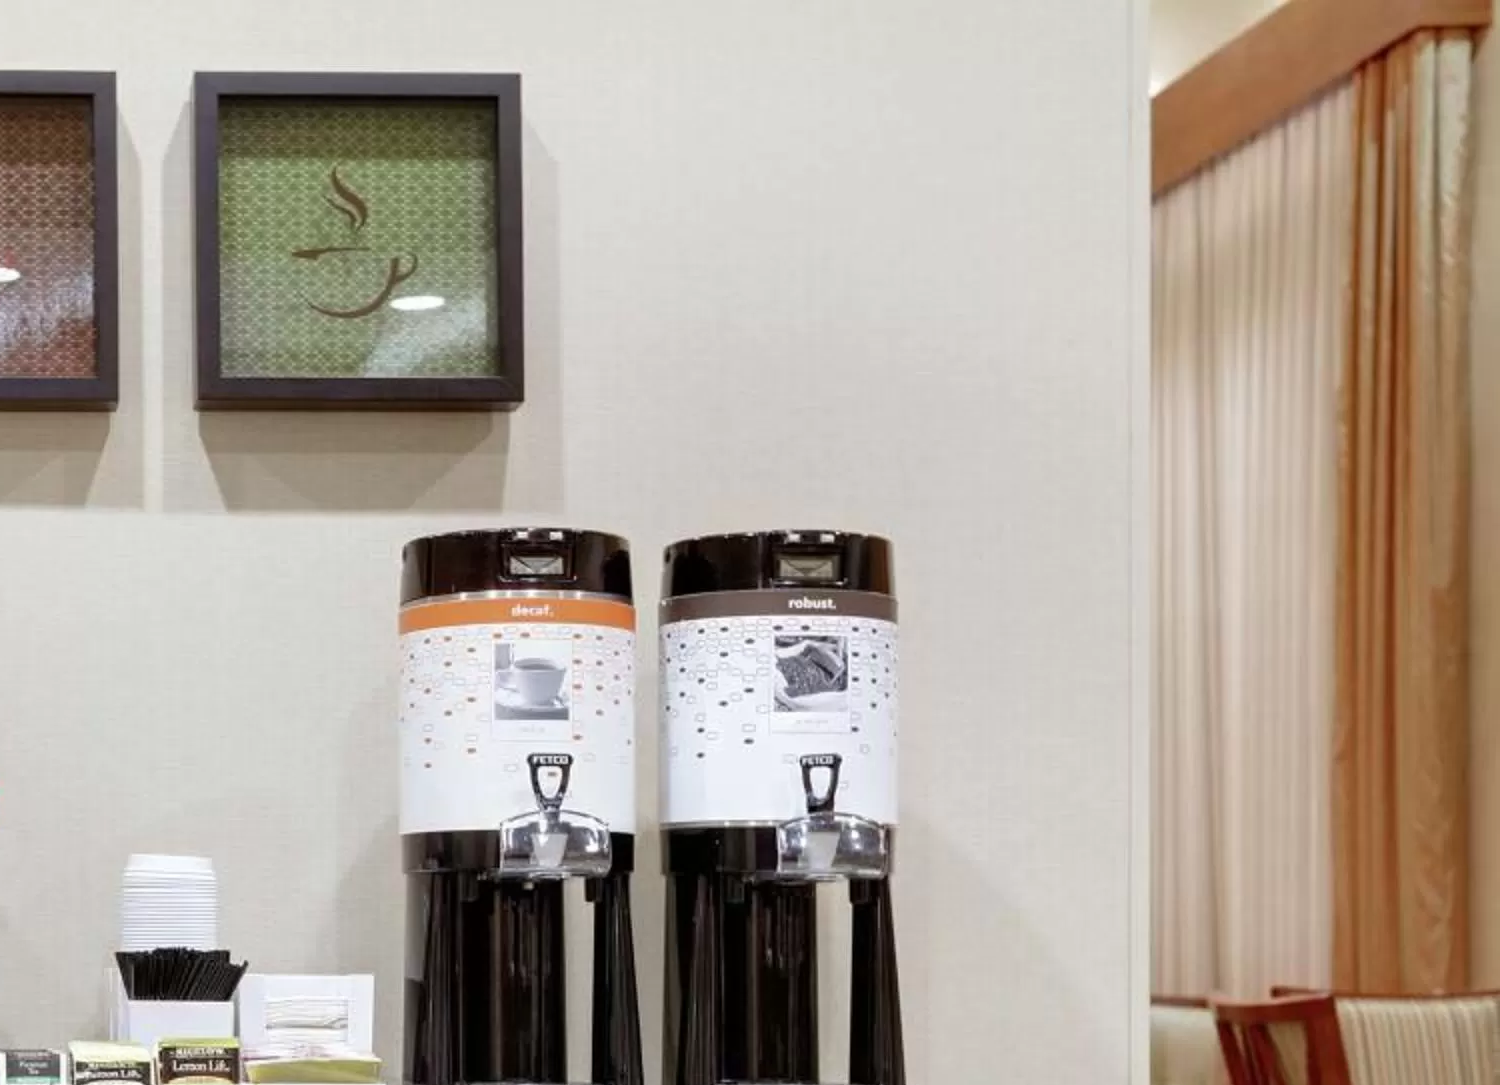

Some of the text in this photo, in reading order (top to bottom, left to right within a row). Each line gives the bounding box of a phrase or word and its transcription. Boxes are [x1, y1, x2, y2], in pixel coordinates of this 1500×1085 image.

[788, 596, 837, 609] robust.
[532, 756, 569, 765] FETCO
[173, 1060, 207, 1072] Lemon
